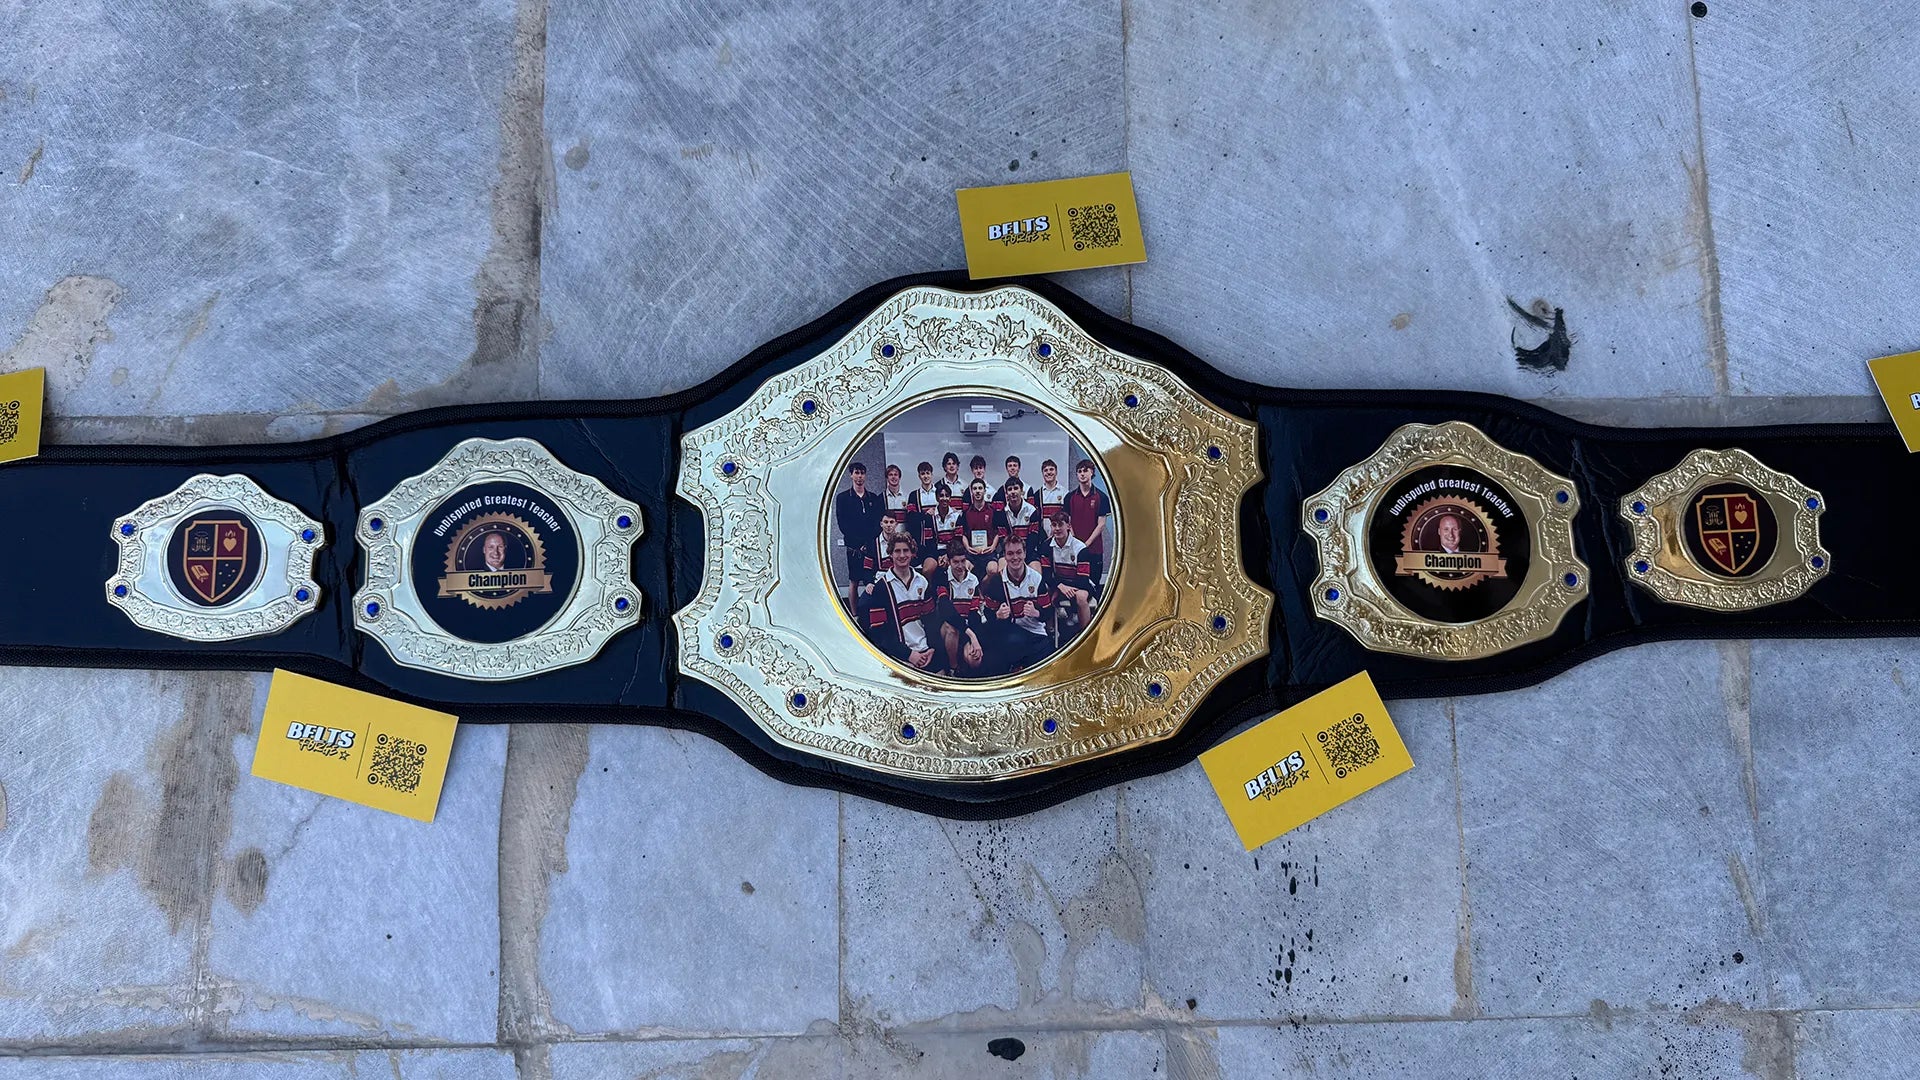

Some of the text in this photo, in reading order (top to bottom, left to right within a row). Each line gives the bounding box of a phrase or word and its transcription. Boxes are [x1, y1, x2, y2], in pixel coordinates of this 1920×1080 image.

[988, 216, 1050, 240] BELTS
[1438, 478, 1480, 493] Greatest
[1481, 487, 1514, 519] Teacher
[484, 495, 528, 508] Greatest
[529, 502, 561, 532] Teacher
[1424, 554, 1482, 569] Champion
[468, 572, 527, 588] Champion
[286, 721, 356, 748] BELTS
[1243, 750, 1305, 801] BELTS
